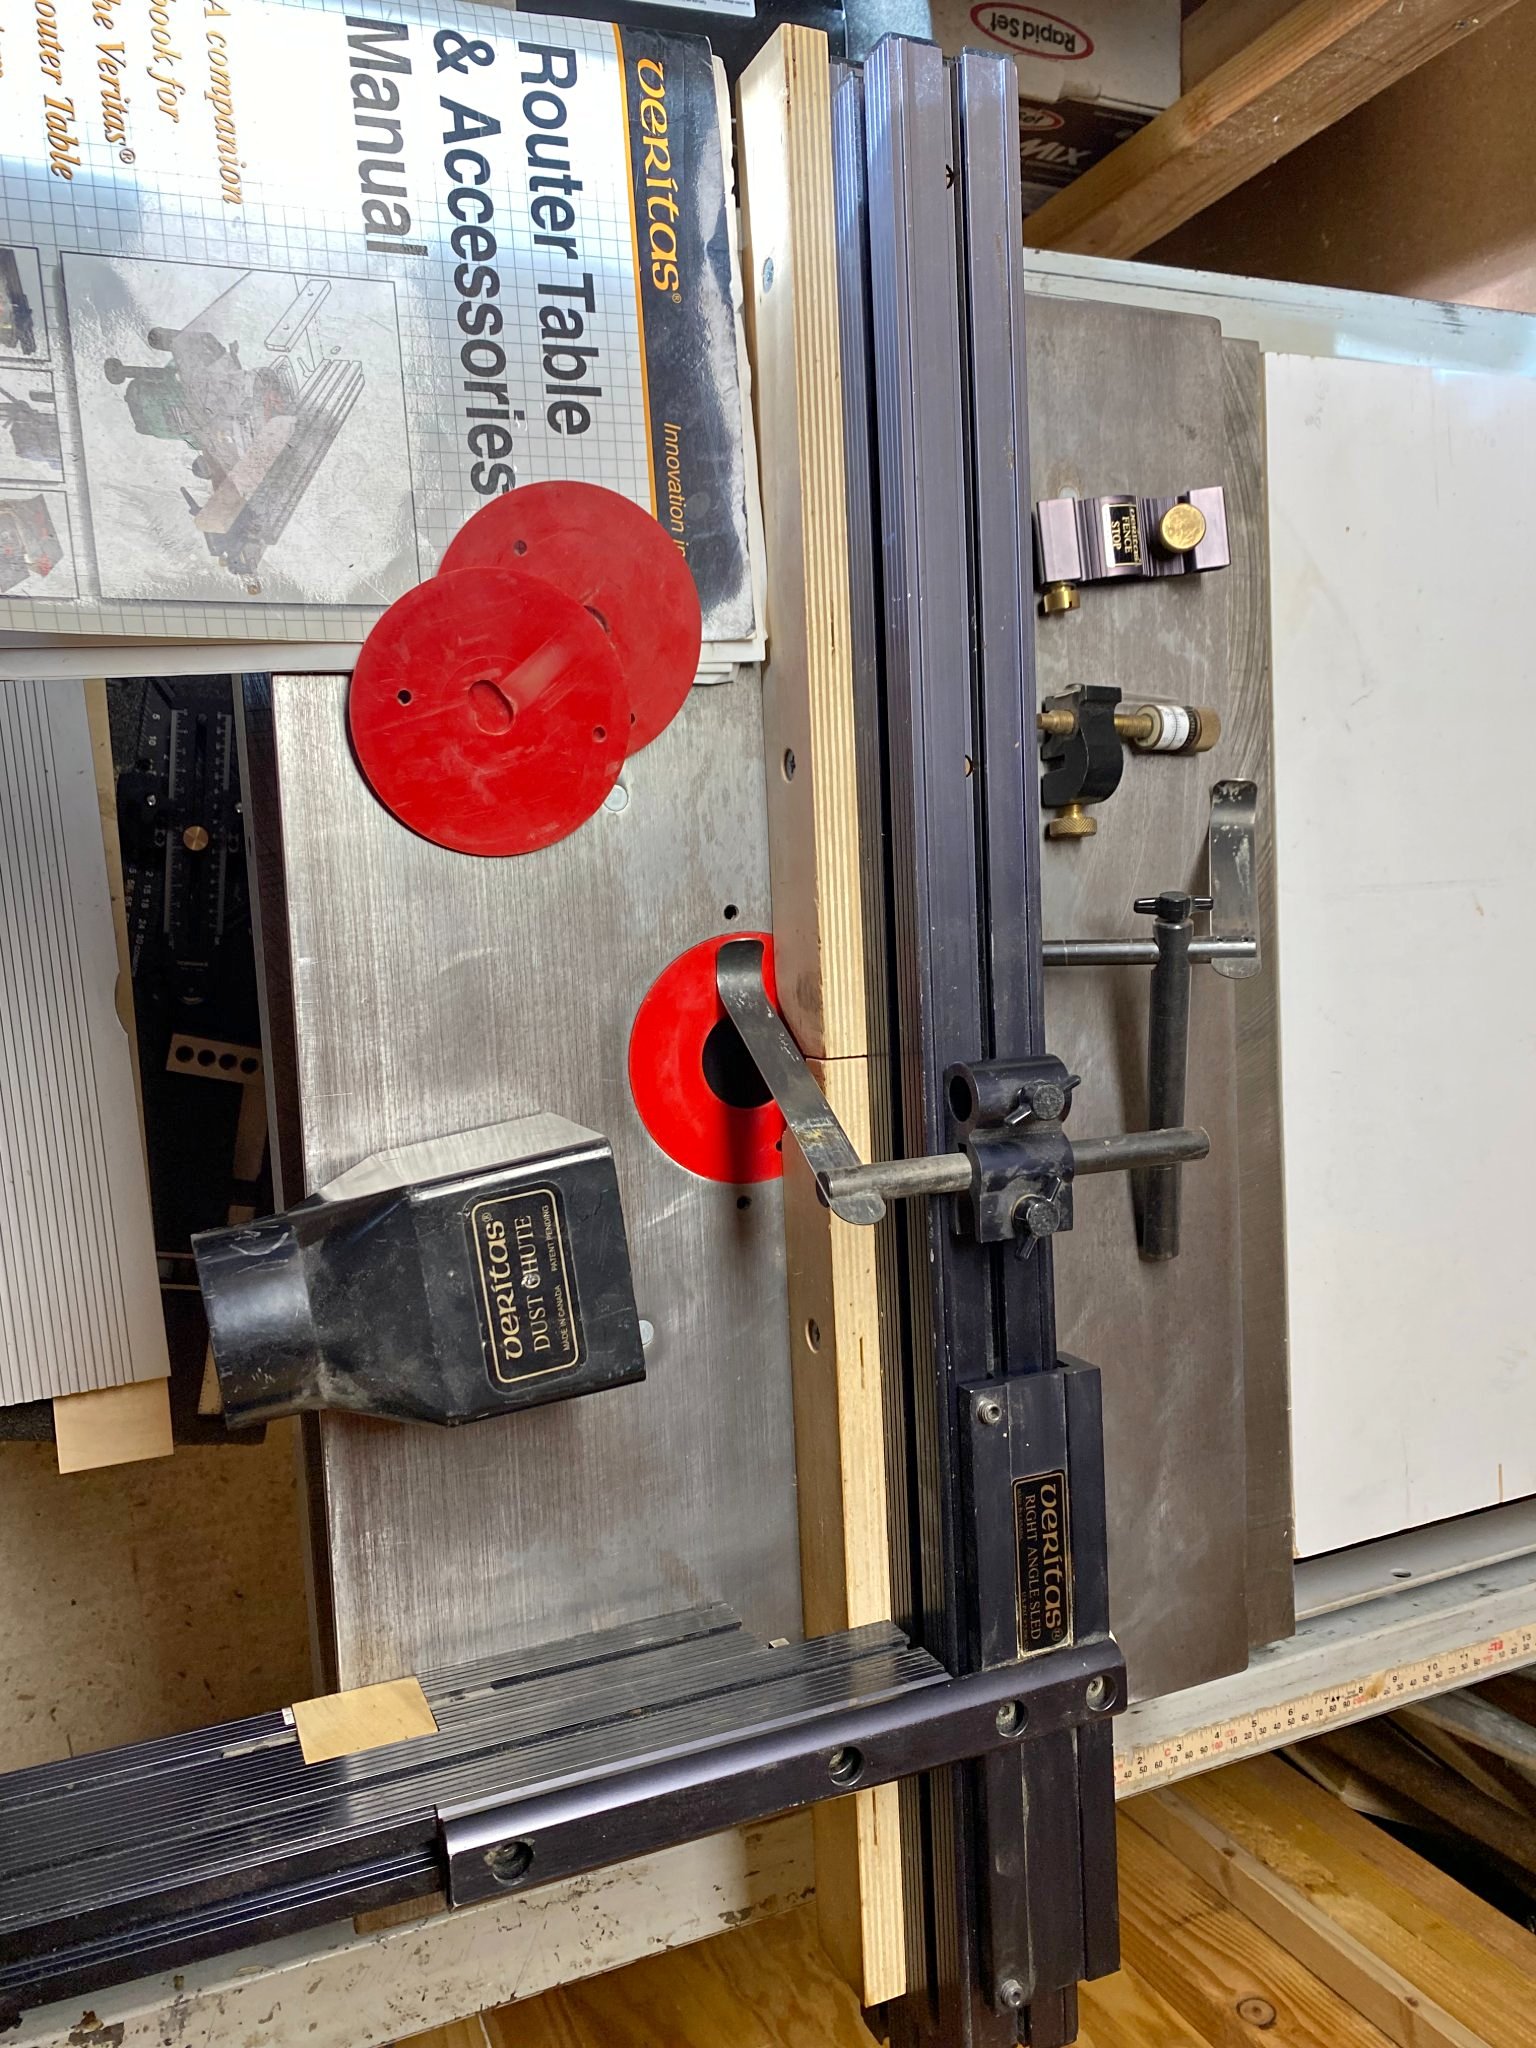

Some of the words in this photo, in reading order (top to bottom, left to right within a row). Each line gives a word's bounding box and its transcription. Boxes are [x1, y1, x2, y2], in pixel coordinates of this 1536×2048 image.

[92, 0, 121, 30] he
[203, 0, 232, 19] A
[991, 12, 1021, 38] Set
[35, 0, 65, 85] outer
[433, 29, 495, 75] &
[1022, 24, 1076, 53] Rapid
[146, 67, 186, 123] for
[204, 30, 247, 205] companion
[43, 94, 81, 181] Table
[345, 15, 428, 257] Manual
[518, 41, 583, 260] Router
[440, 96, 524, 495] Accessories
[537, 272, 602, 435] Table
[663, 422, 686, 532] Innovation
[1111, 521, 1122, 550] STOP
[1122, 516, 1132, 553] FENCE
[542, 1205, 553, 1240] PENDING
[514, 1215, 541, 1289] CHUTE
[547, 1242, 558, 1272] PATENT
[526, 1295, 551, 1351] DUST
[555, 1285, 565, 1317] CANADA
[561, 1328, 570, 1351] MADE
[1025, 1494, 1037, 1541] RIGHT
[1027, 1547, 1039, 1597] ANGLE
[1029, 1602, 1041, 1640] SLED
